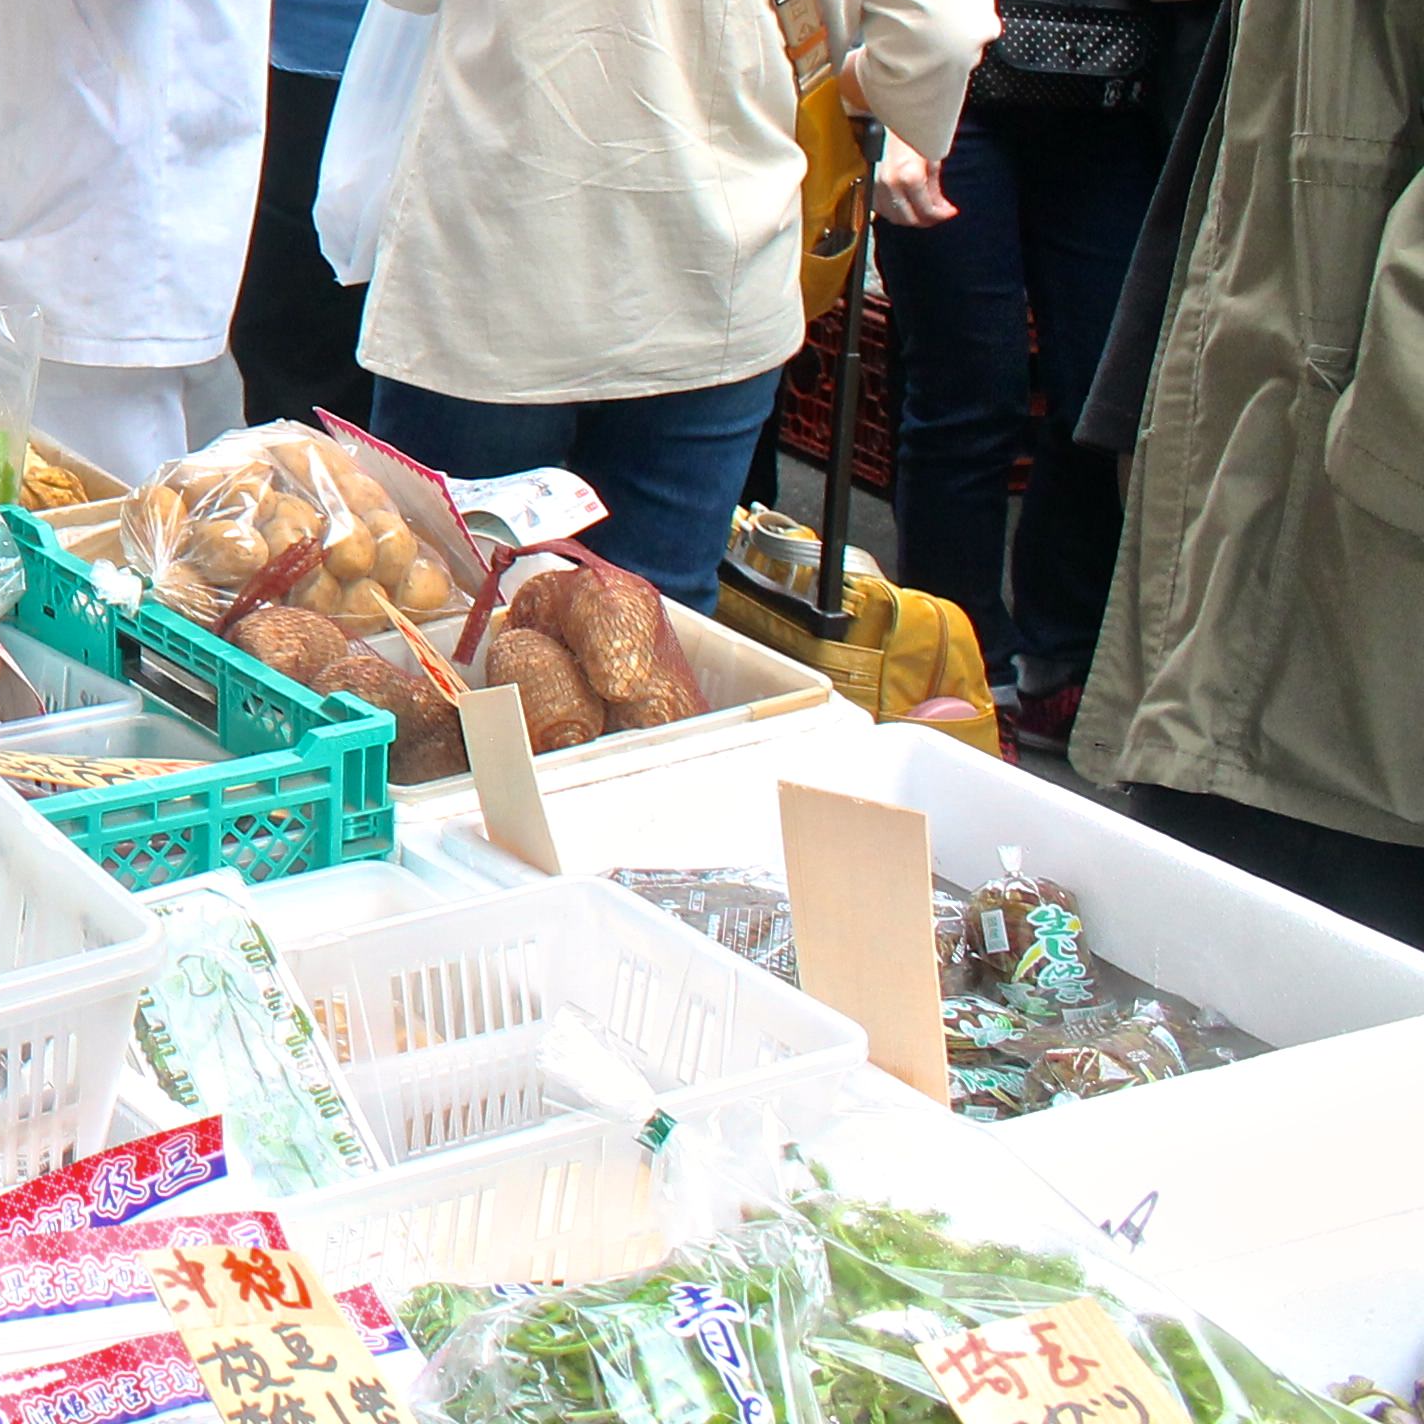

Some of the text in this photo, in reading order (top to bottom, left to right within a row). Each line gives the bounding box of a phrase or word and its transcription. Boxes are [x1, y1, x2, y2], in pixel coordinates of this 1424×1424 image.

[92, 1132, 210, 1214] 枝豆
[152, 1247, 313, 1313] 沖縄
[197, 1322, 338, 1396] 枝豆
[936, 1321, 1100, 1404] 埼玉
